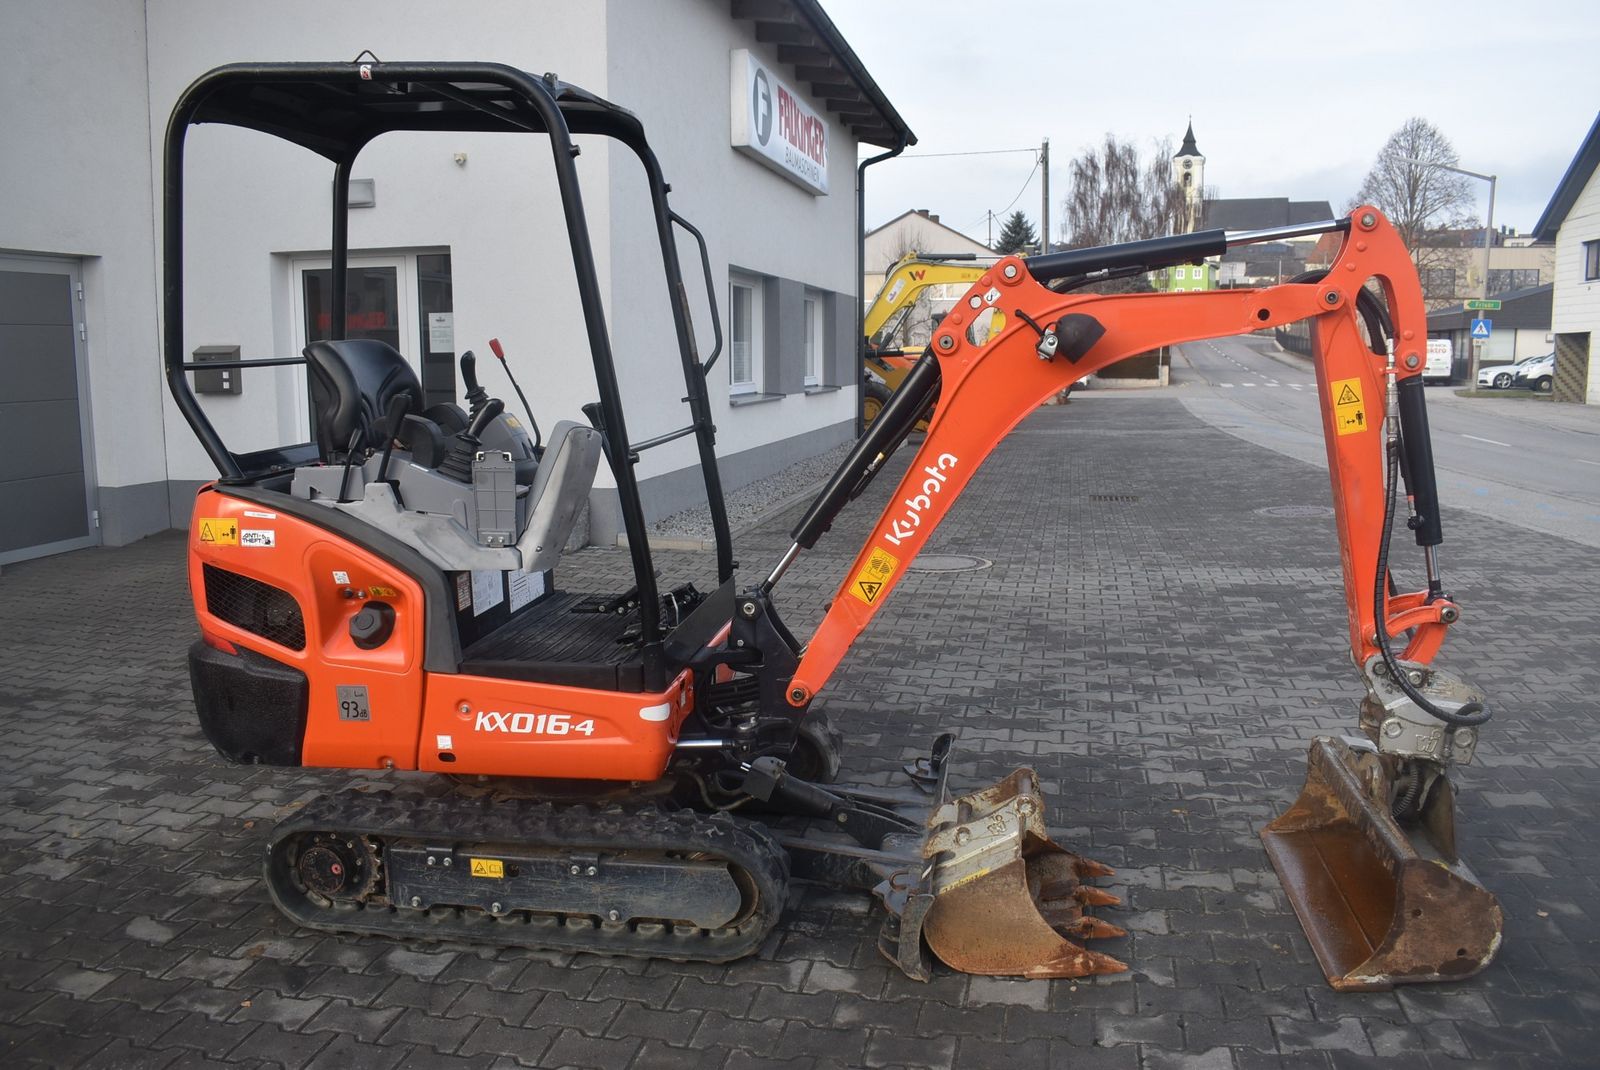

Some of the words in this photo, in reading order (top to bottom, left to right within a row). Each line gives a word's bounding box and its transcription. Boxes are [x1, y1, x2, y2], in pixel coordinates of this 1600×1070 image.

[785, 146, 821, 183] BAUMASCHINEN
[884, 453, 958, 545] Kubota
[341, 701, 359, 718] 93
[474, 711, 594, 737] KX016-4
